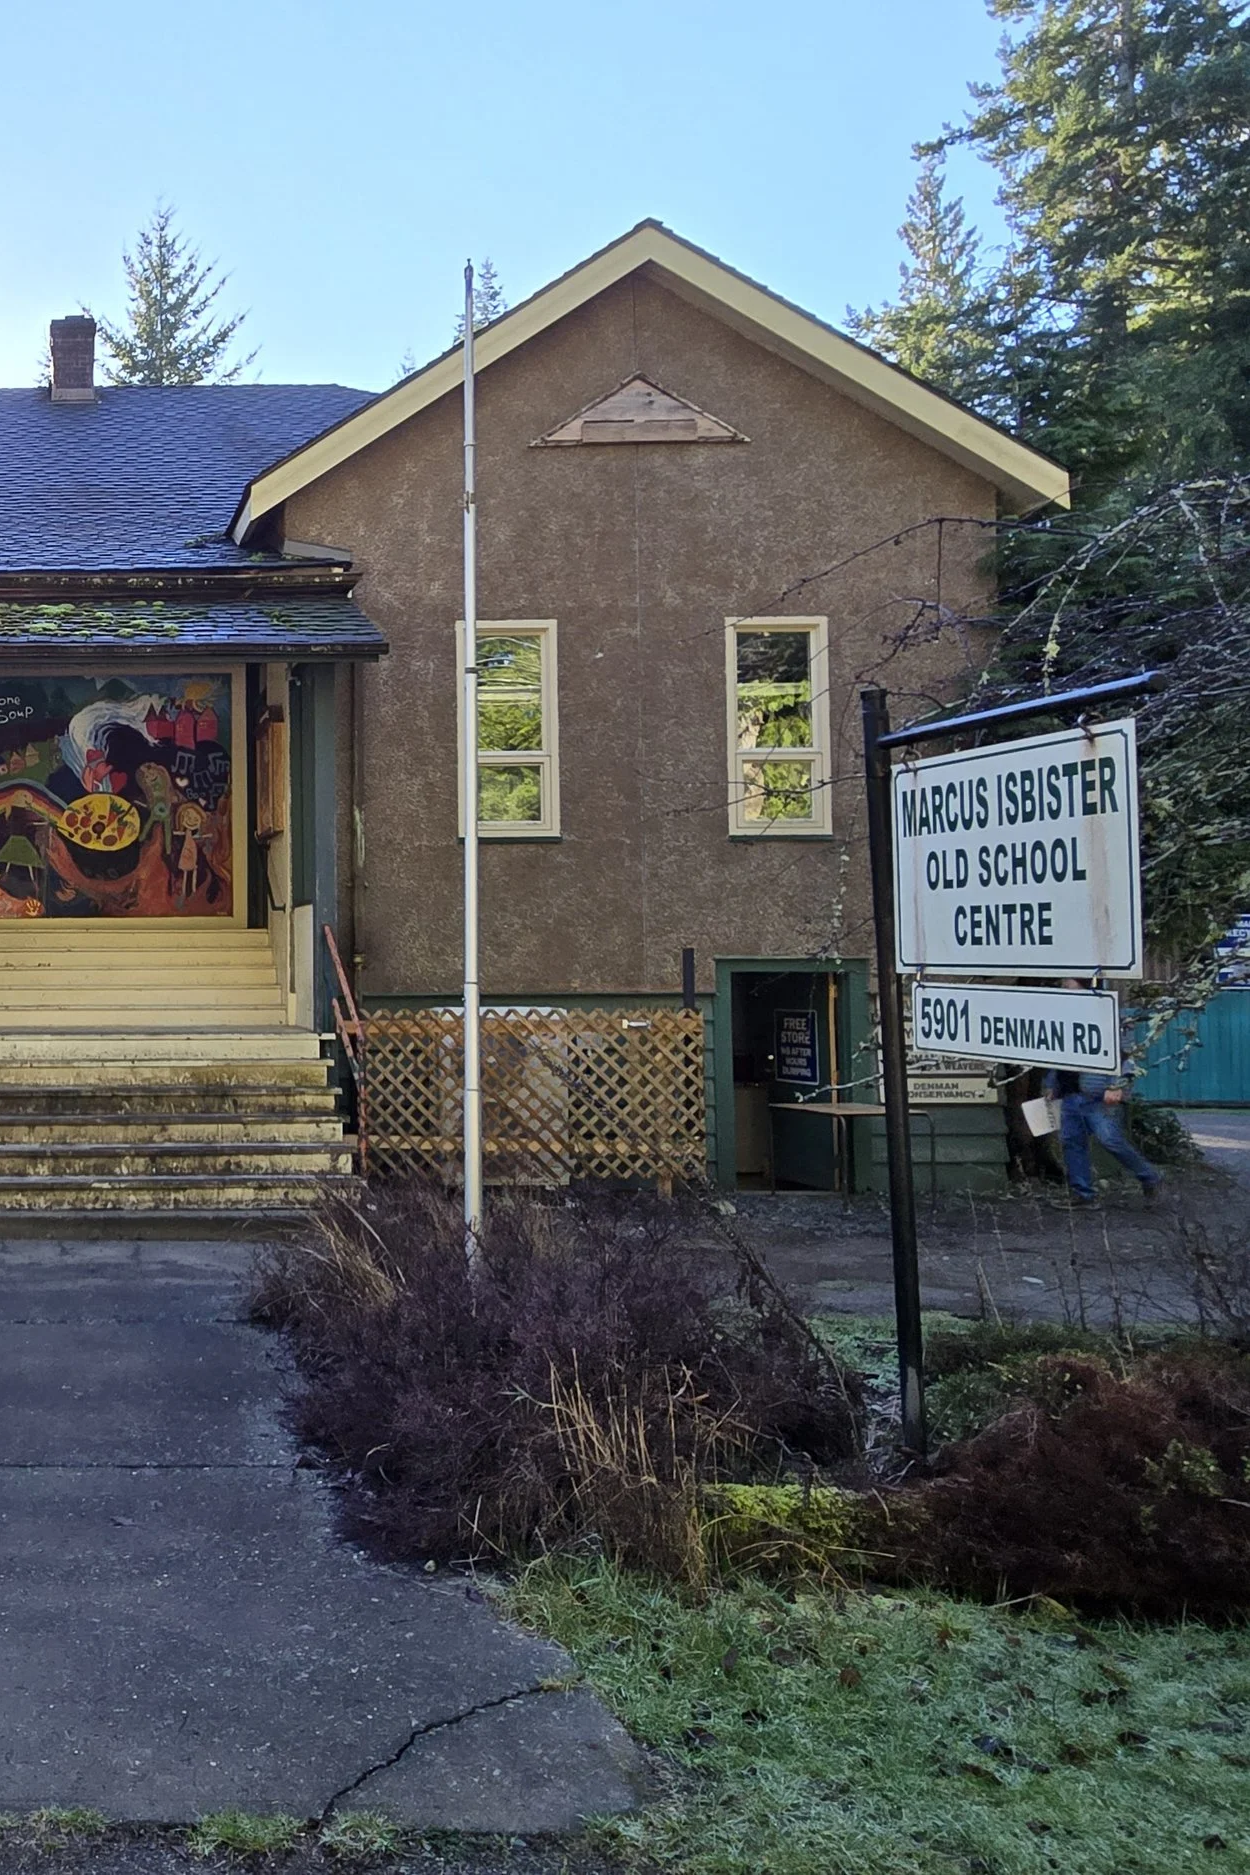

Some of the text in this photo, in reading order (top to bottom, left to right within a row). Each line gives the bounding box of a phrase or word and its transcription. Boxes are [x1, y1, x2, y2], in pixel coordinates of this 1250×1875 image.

[901, 756, 1119, 838] MARCUS ISBISTER
[926, 837, 1087, 891] OLD SCHOOL
[954, 902, 1053, 946] CENTRE
[780, 1031, 811, 1045] STORE
[783, 1017, 807, 1031] FREE
[921, 997, 1109, 1057] 5901 DENMAN RD.
[907, 1090, 976, 1099] ONSERVANCY
